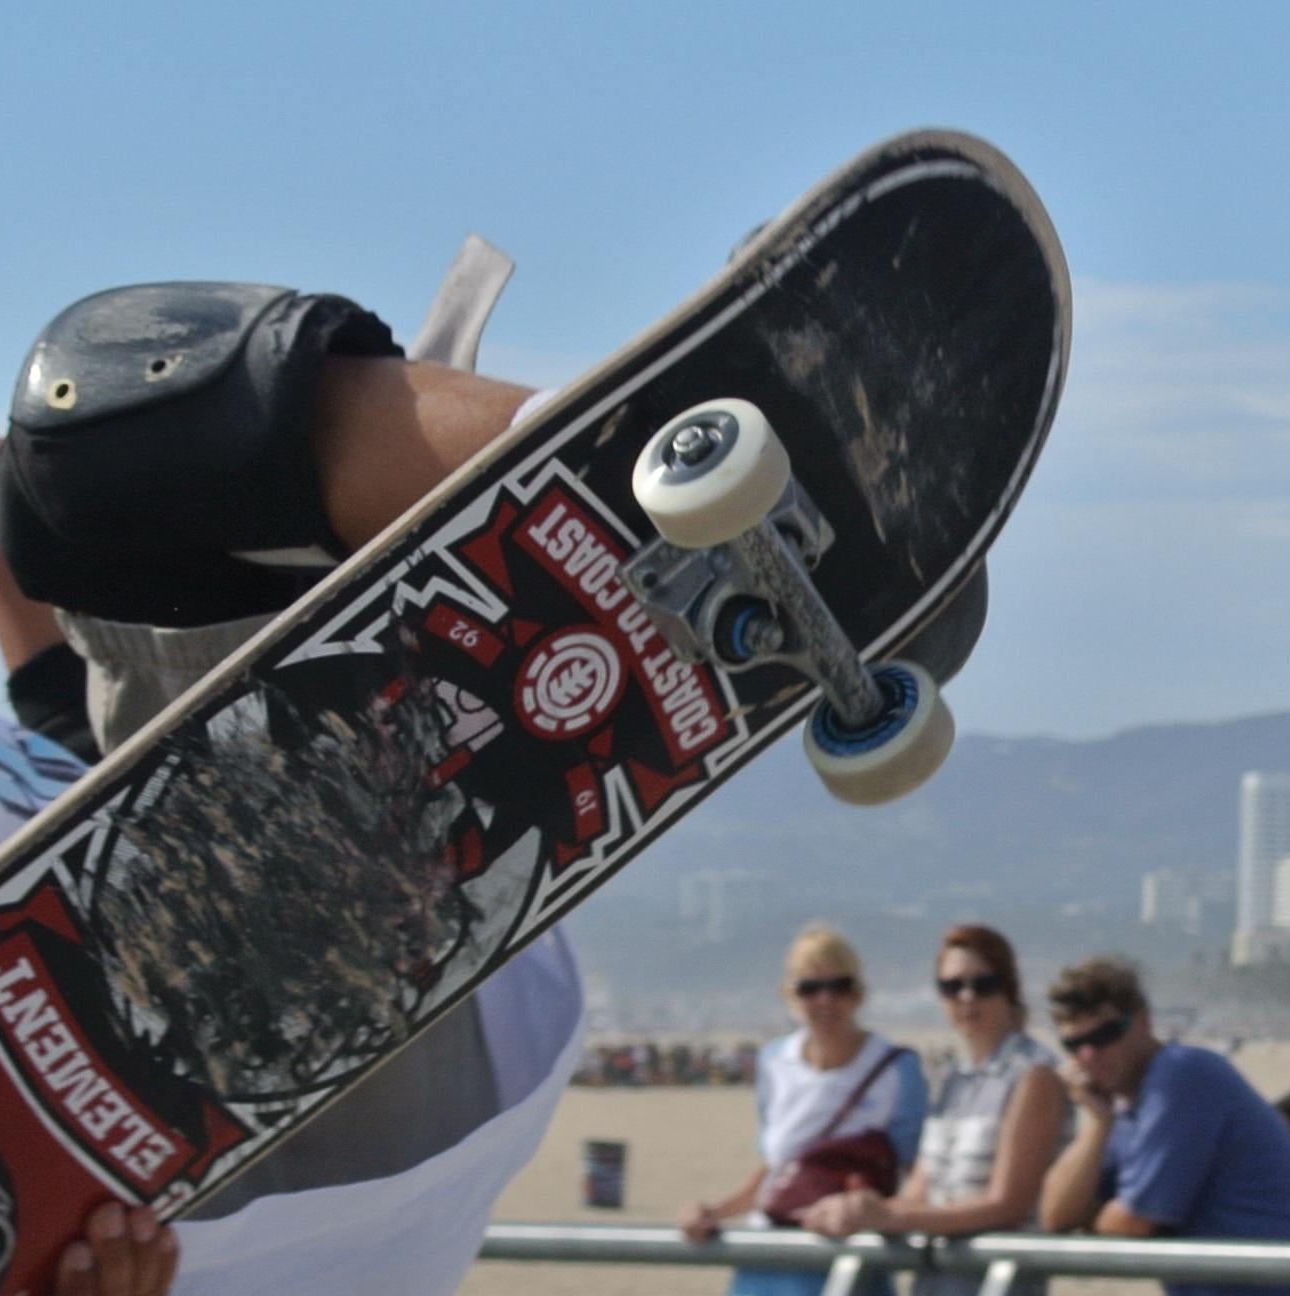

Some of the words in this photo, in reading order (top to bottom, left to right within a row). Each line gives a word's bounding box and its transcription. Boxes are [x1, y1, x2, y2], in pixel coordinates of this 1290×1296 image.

[527, 503, 629, 611] COAST
[448, 619, 482, 649] 92
[616, 603, 658, 653] TO
[644, 649, 718, 750] COAST
[575, 789, 598, 816] 19
